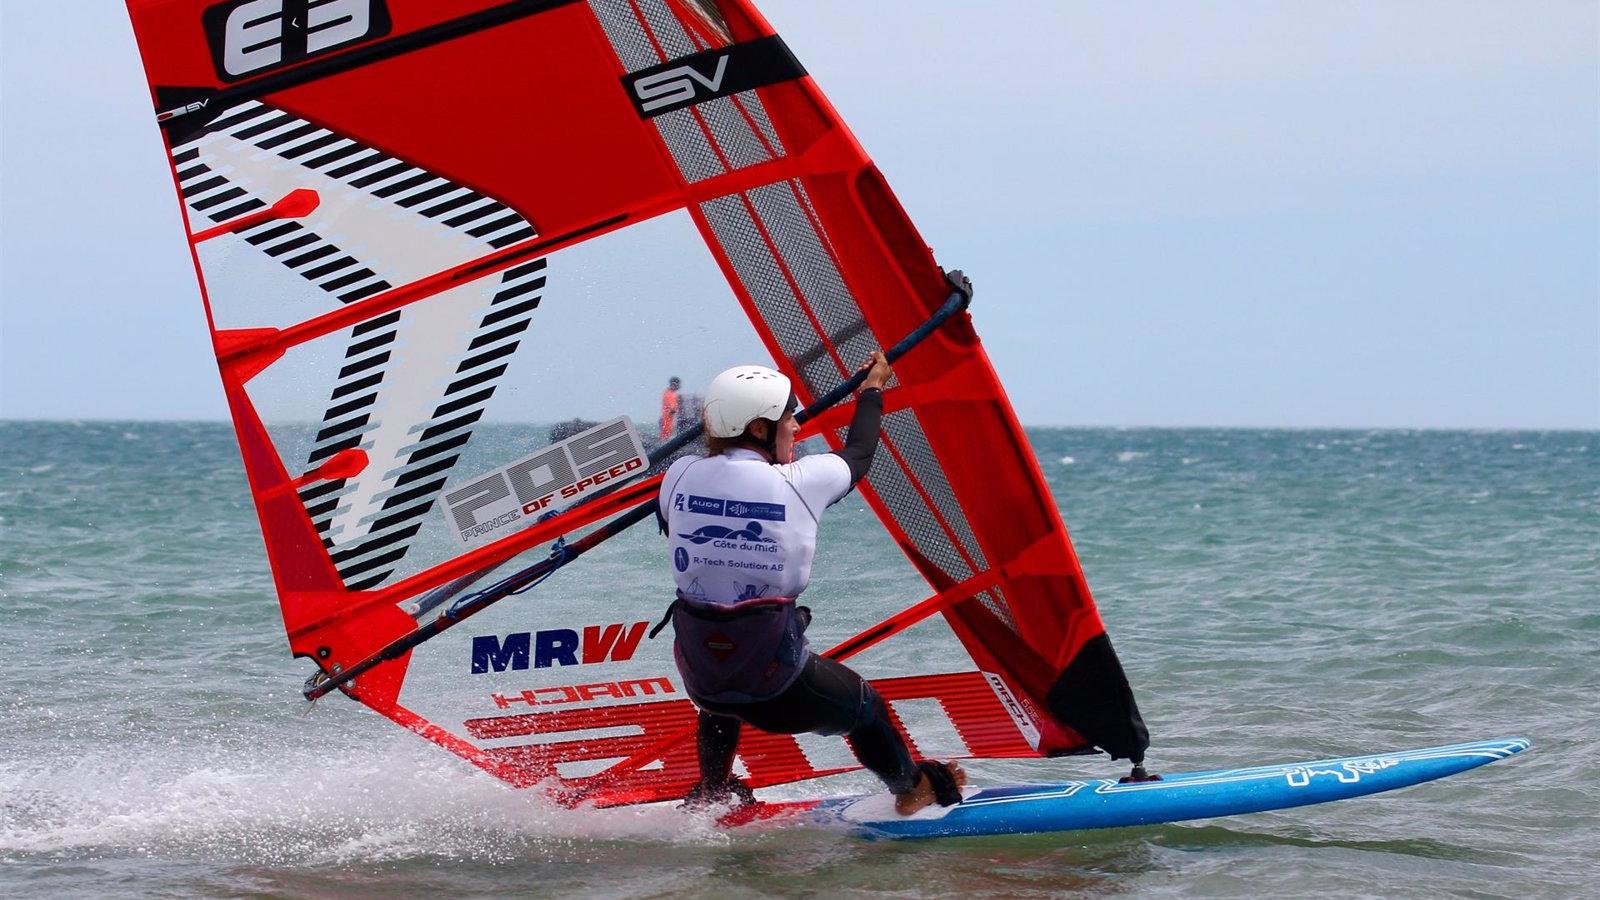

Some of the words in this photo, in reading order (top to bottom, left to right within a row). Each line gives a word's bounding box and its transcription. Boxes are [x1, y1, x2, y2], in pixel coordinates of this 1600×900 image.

[186, 98, 209, 113] SV
[634, 54, 730, 113] SV
[445, 420, 638, 531] POS
[460, 508, 521, 542] PRINCE
[522, 494, 555, 515] OF
[561, 457, 643, 499] SPEED
[693, 556, 726, 566] R-Tech
[728, 560, 768, 571] Solution
[770, 563, 784, 572] AB
[713, 540, 737, 549] Côte
[739, 541, 753, 551] du
[471, 621, 650, 674] MRW
[991, 676, 1029, 726] MACH
